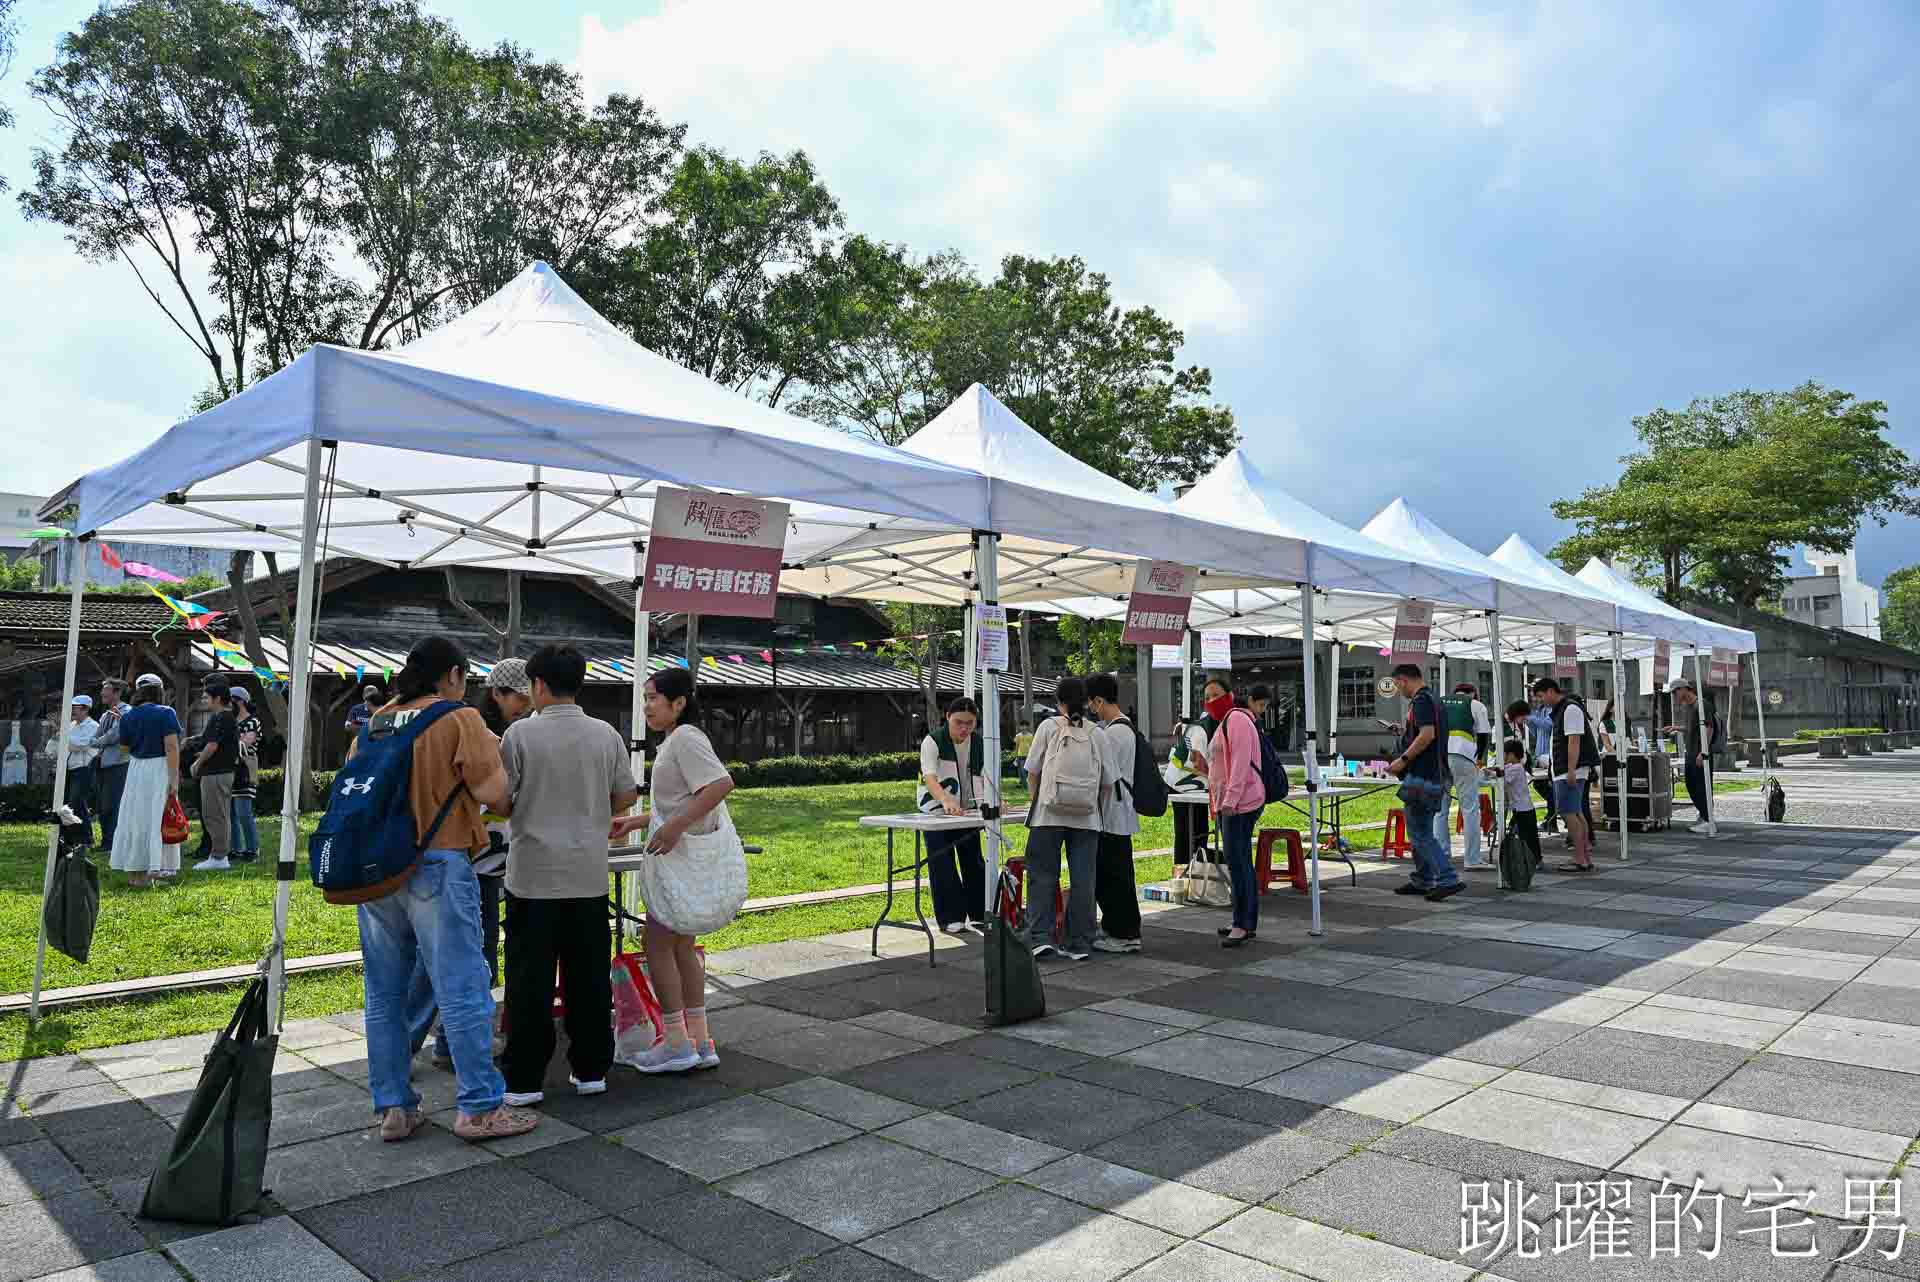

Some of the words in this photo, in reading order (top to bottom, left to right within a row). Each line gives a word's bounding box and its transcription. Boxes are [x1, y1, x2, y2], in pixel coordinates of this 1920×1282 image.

[652, 563, 773, 595] 平衡守護任務
